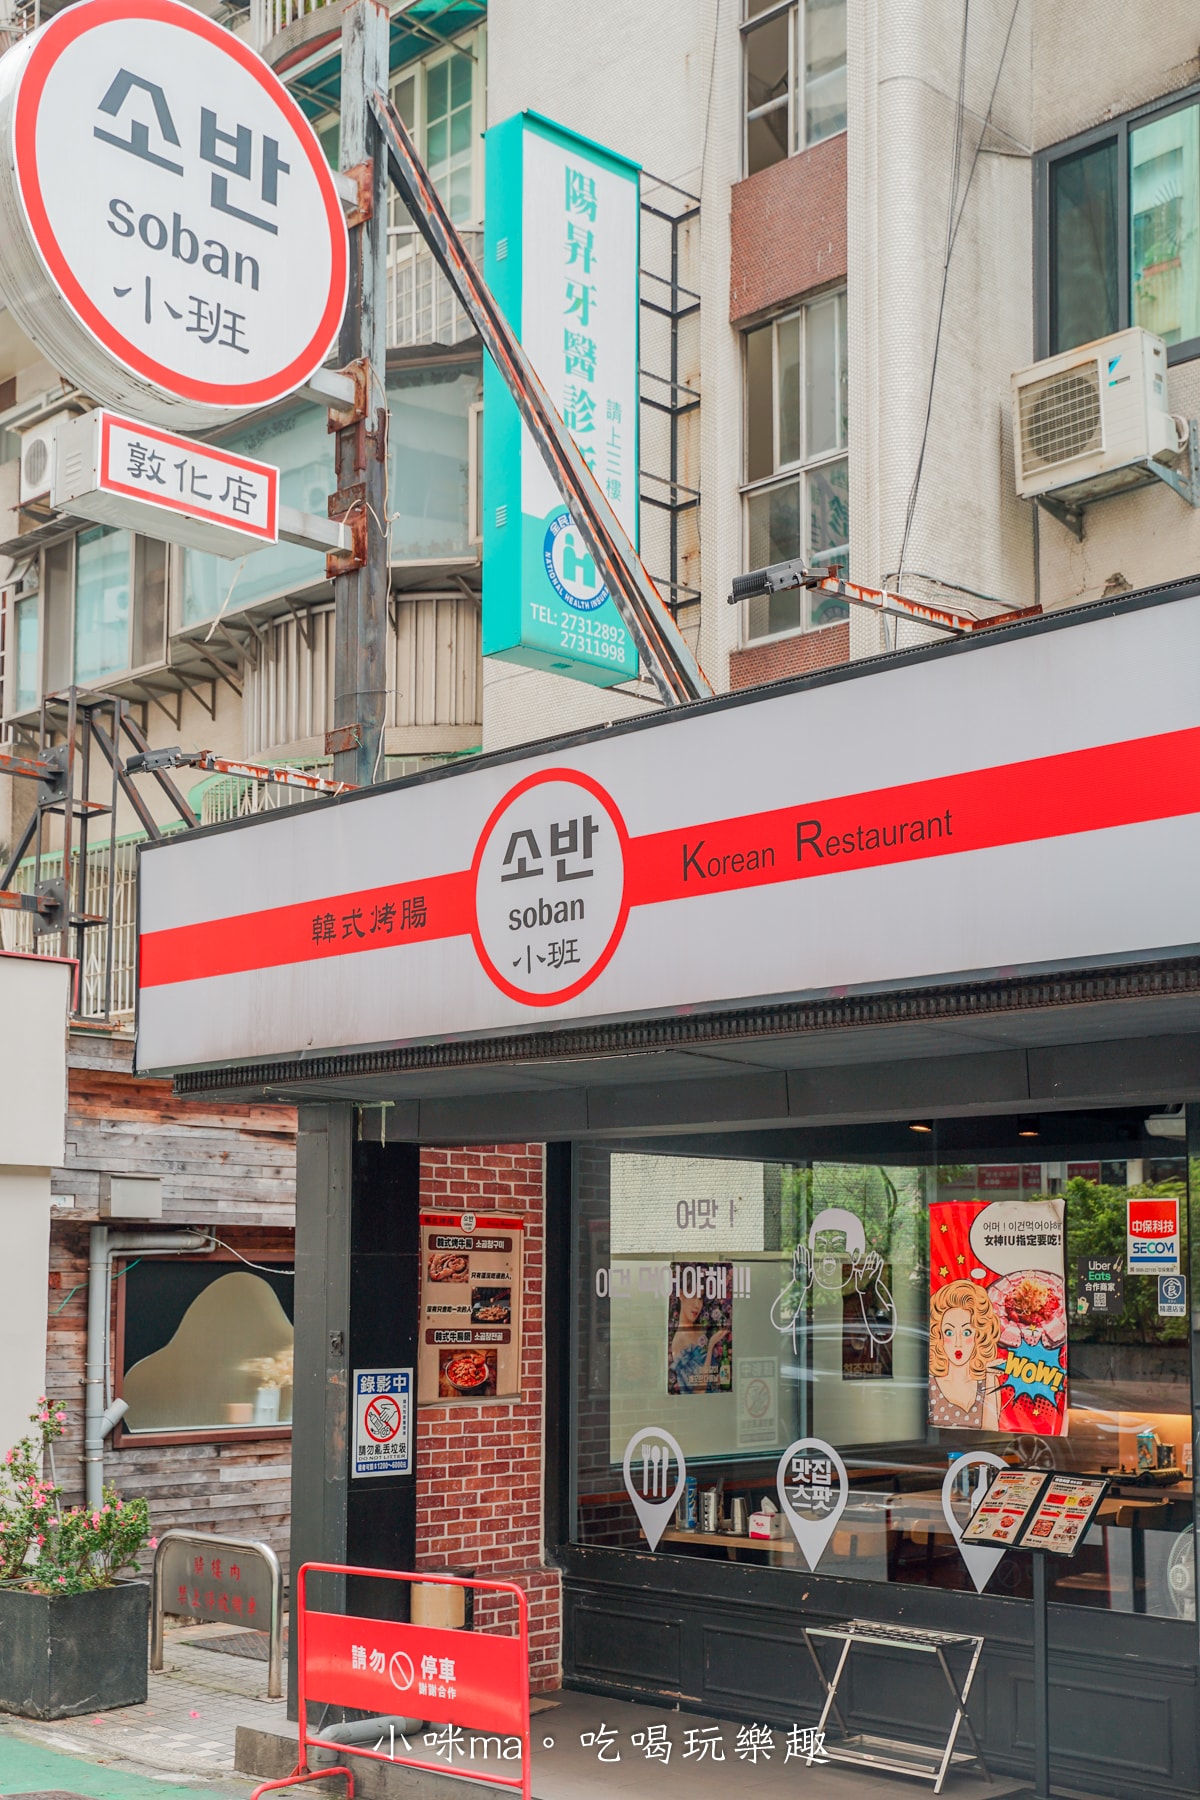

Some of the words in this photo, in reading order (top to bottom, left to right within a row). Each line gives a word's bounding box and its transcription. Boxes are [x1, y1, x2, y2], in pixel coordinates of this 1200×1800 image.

[93, 67, 291, 236] 소반
[106, 197, 260, 292] soban
[112, 275, 250, 355] 小班
[606, 398, 622, 502] 請上三樓
[126, 441, 258, 516] 敦化店
[544, 551, 564, 596] NATIONAL
[564, 592, 591, 610] HEALTH
[530, 602, 558, 626] TEL:
[561, 612, 625, 645] 27312892
[560, 631, 625, 664] 27311998
[500, 814, 599, 883] 소반
[683, 841, 776, 881] Korean
[797, 809, 954, 862] Restaurant
[311, 896, 428, 946] 韓式烤腸
[508, 896, 585, 931] soban
[512, 938, 582, 974] 小班
[984, 1234, 1062, 1247] 女神IU指定要吃!
[1131, 1219, 1175, 1234] 中保科技
[1088, 1260, 1111, 1271] Uber
[1132, 1241, 1174, 1255] SECOM
[1085, 1282, 1116, 1292] 合作商家
[1088, 1271, 1111, 1281] Eats
[360, 1374, 407, 1393] 錄影中
[1005, 1350, 1063, 1393] WOW!
[358, 1443, 406, 1456] 請勿亂丟垃圾
[791, 1458, 832, 1485] 맛집
[791, 1485, 833, 1511] 스팟
[351, 1645, 386, 1674] 請勿
[420, 1654, 457, 1683] 停車
[418, 1682, 457, 1700] 謝謝合作
